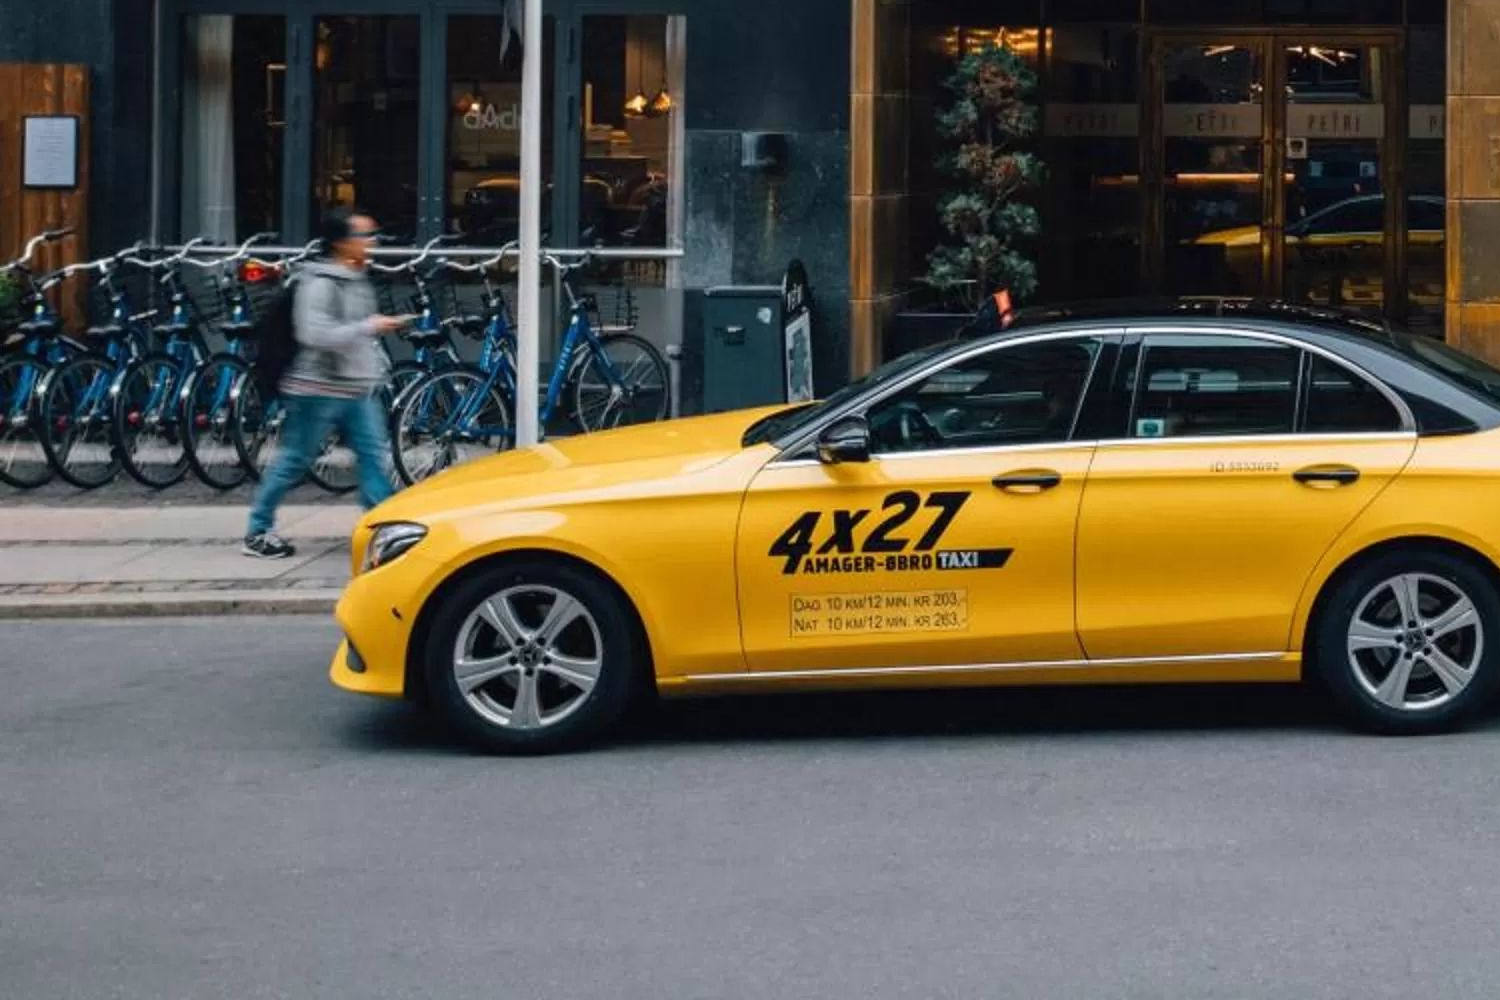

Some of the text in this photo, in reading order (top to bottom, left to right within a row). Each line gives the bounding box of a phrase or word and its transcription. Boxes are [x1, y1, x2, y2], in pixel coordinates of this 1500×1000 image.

[803, 551, 979, 575] AMAGER-ØBRO TAXI
[827, 596, 842, 610] 10
[828, 617, 843, 631] 10
